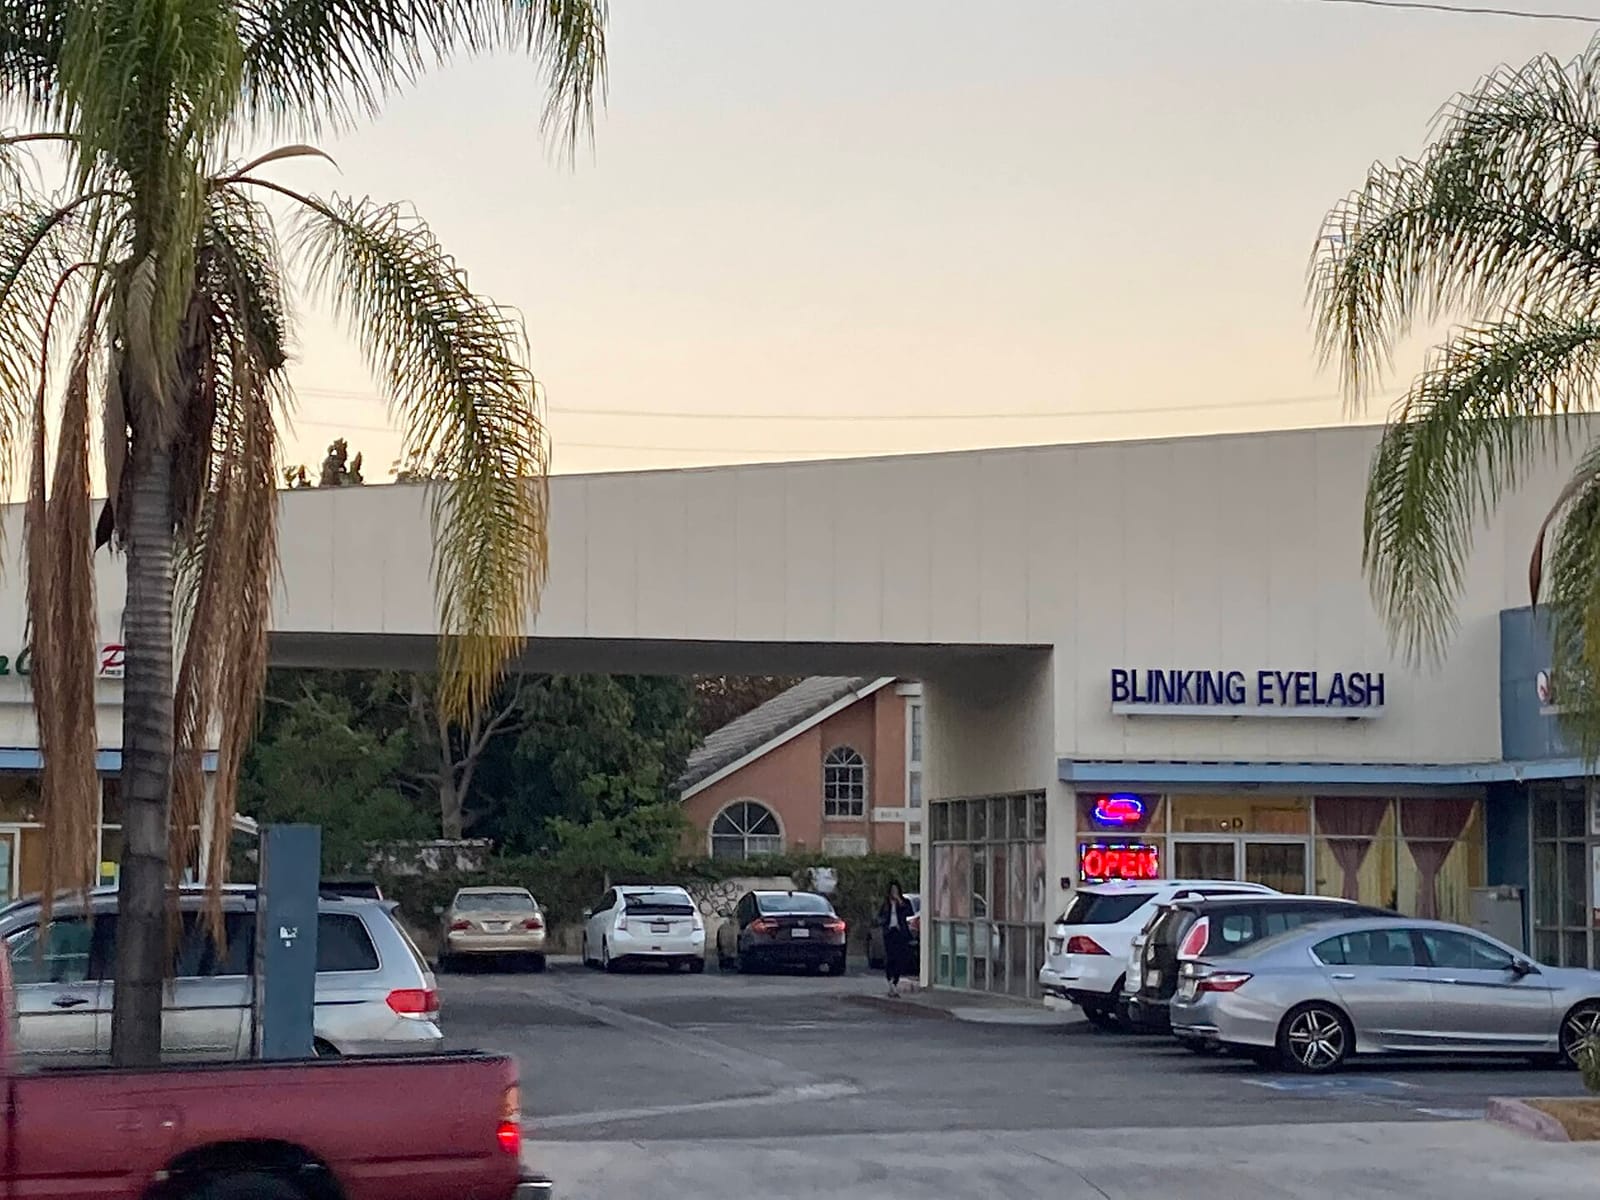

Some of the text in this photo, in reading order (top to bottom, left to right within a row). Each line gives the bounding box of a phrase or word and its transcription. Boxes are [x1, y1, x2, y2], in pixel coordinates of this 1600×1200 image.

[1111, 669, 1385, 706] BLINKING EYELASH
[1084, 849, 1158, 878] OPEN
